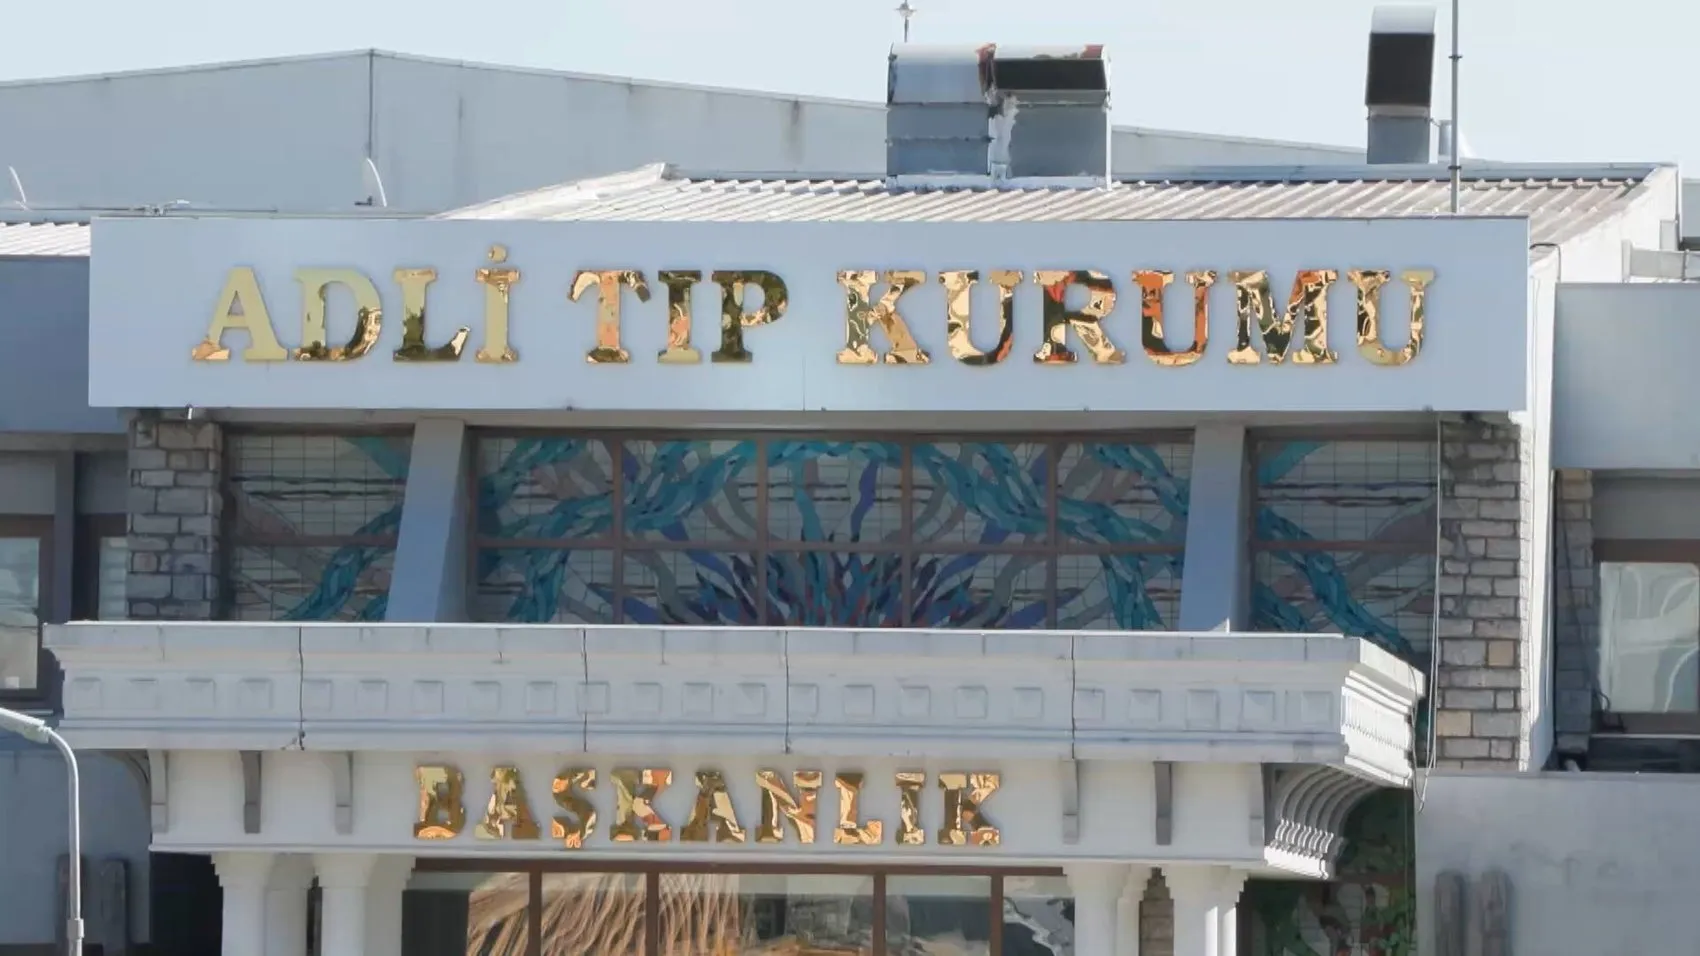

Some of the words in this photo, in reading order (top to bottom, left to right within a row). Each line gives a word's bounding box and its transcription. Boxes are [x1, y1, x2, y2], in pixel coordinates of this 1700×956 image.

[191, 245, 521, 363] ADLİ
[568, 268, 789, 364] TIP
[836, 268, 1436, 366] KURUMU
[413, 765, 1001, 849] BAŞKANLIK
